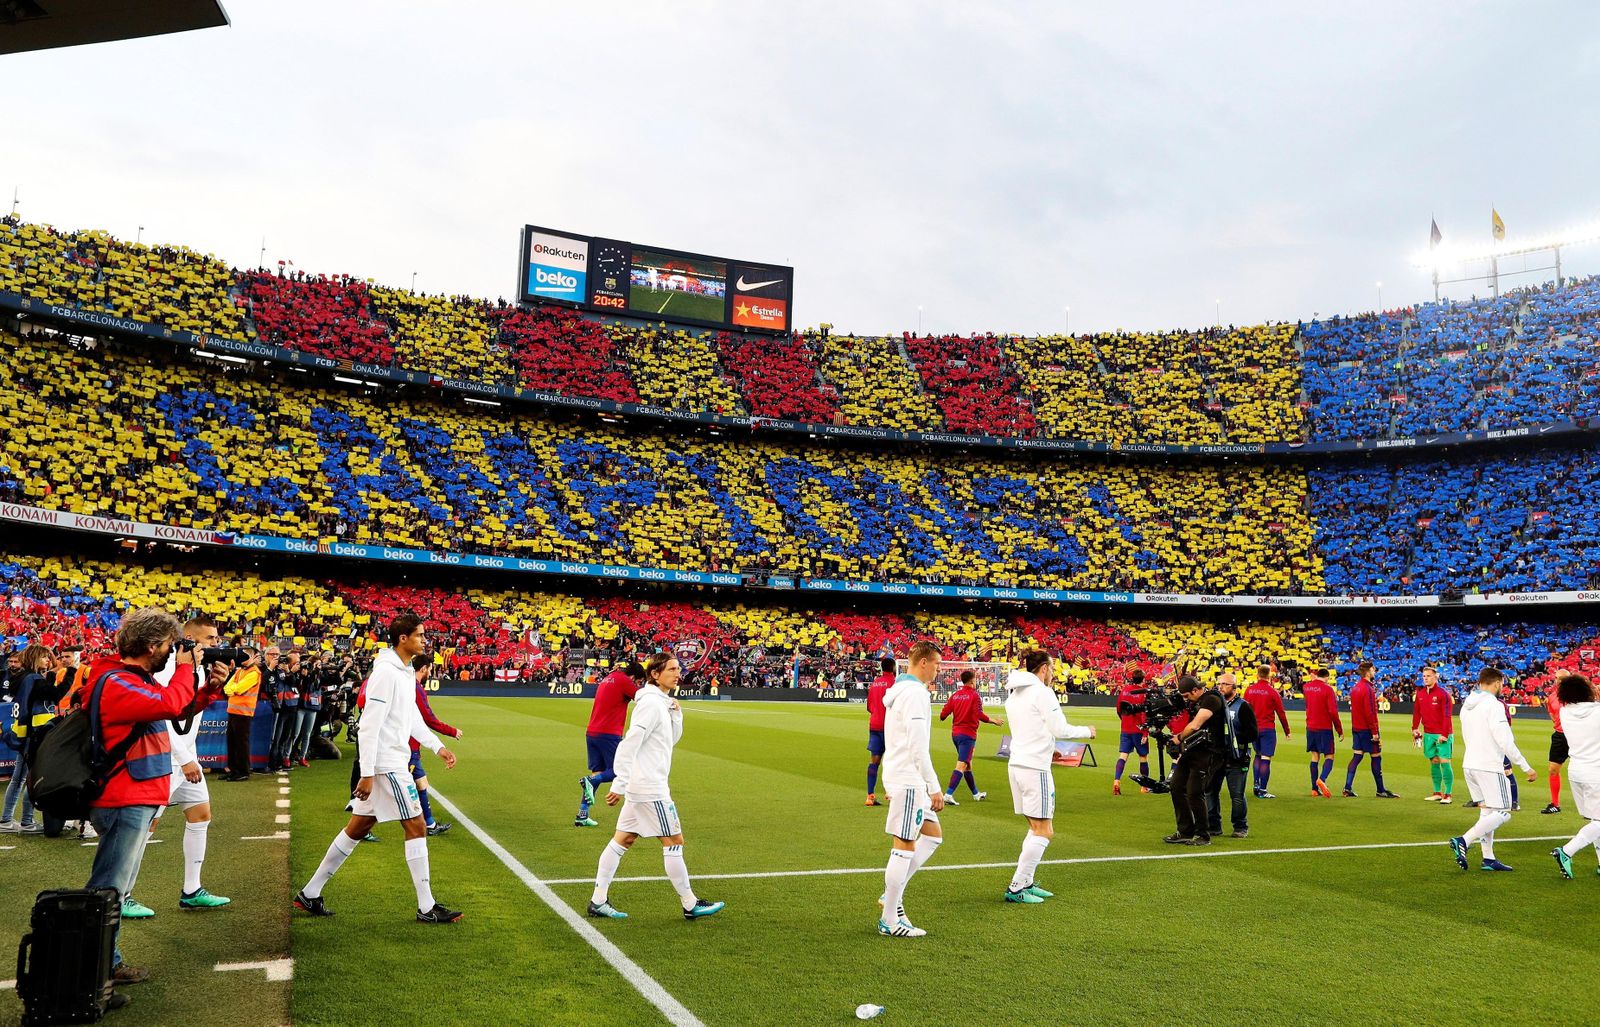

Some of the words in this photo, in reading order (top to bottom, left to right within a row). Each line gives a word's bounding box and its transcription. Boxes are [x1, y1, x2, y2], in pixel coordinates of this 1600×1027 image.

[543, 246, 585, 261] Rakuten
[536, 268, 577, 288] beko
[593, 294, 625, 309] 20:42
[752, 305, 783, 318] Estrella
[51, 306, 144, 332] FCBARCELONA.COM
[535, 393, 601, 408] FCBARCELONA.COM
[826, 426, 887, 437] FCBARCELONA.COM
[921, 433, 981, 444] FCBARCELONA.COM
[1015, 439, 1075, 449] FCBARCELONA.COM
[1, 504, 57, 524] KONAMI
[75, 516, 135, 534] KONAMI
[154, 526, 215, 542] KONAMI
[232, 534, 267, 548] beko
[285, 539, 318, 552] beko
[335, 544, 367, 556] beko
[384, 549, 414, 560] beko
[430, 553, 460, 564] beko
[475, 556, 504, 568] beko
[519, 560, 547, 571] beko
[561, 563, 589, 574] beko
[602, 566, 629, 577] beko
[639, 569, 666, 580] beko
[675, 571, 701, 582] beko
[712, 574, 737, 584] beko
[774, 579, 792, 587] beko
[920, 585, 944, 595] beko
[956, 587, 981, 597] beko
[993, 588, 1018, 598] beko
[1033, 590, 1057, 600] beko
[1067, 591, 1091, 601] beko
[1103, 592, 1128, 602] beko
[406, 783, 418, 802] 5
[915, 808, 923, 826] 8
